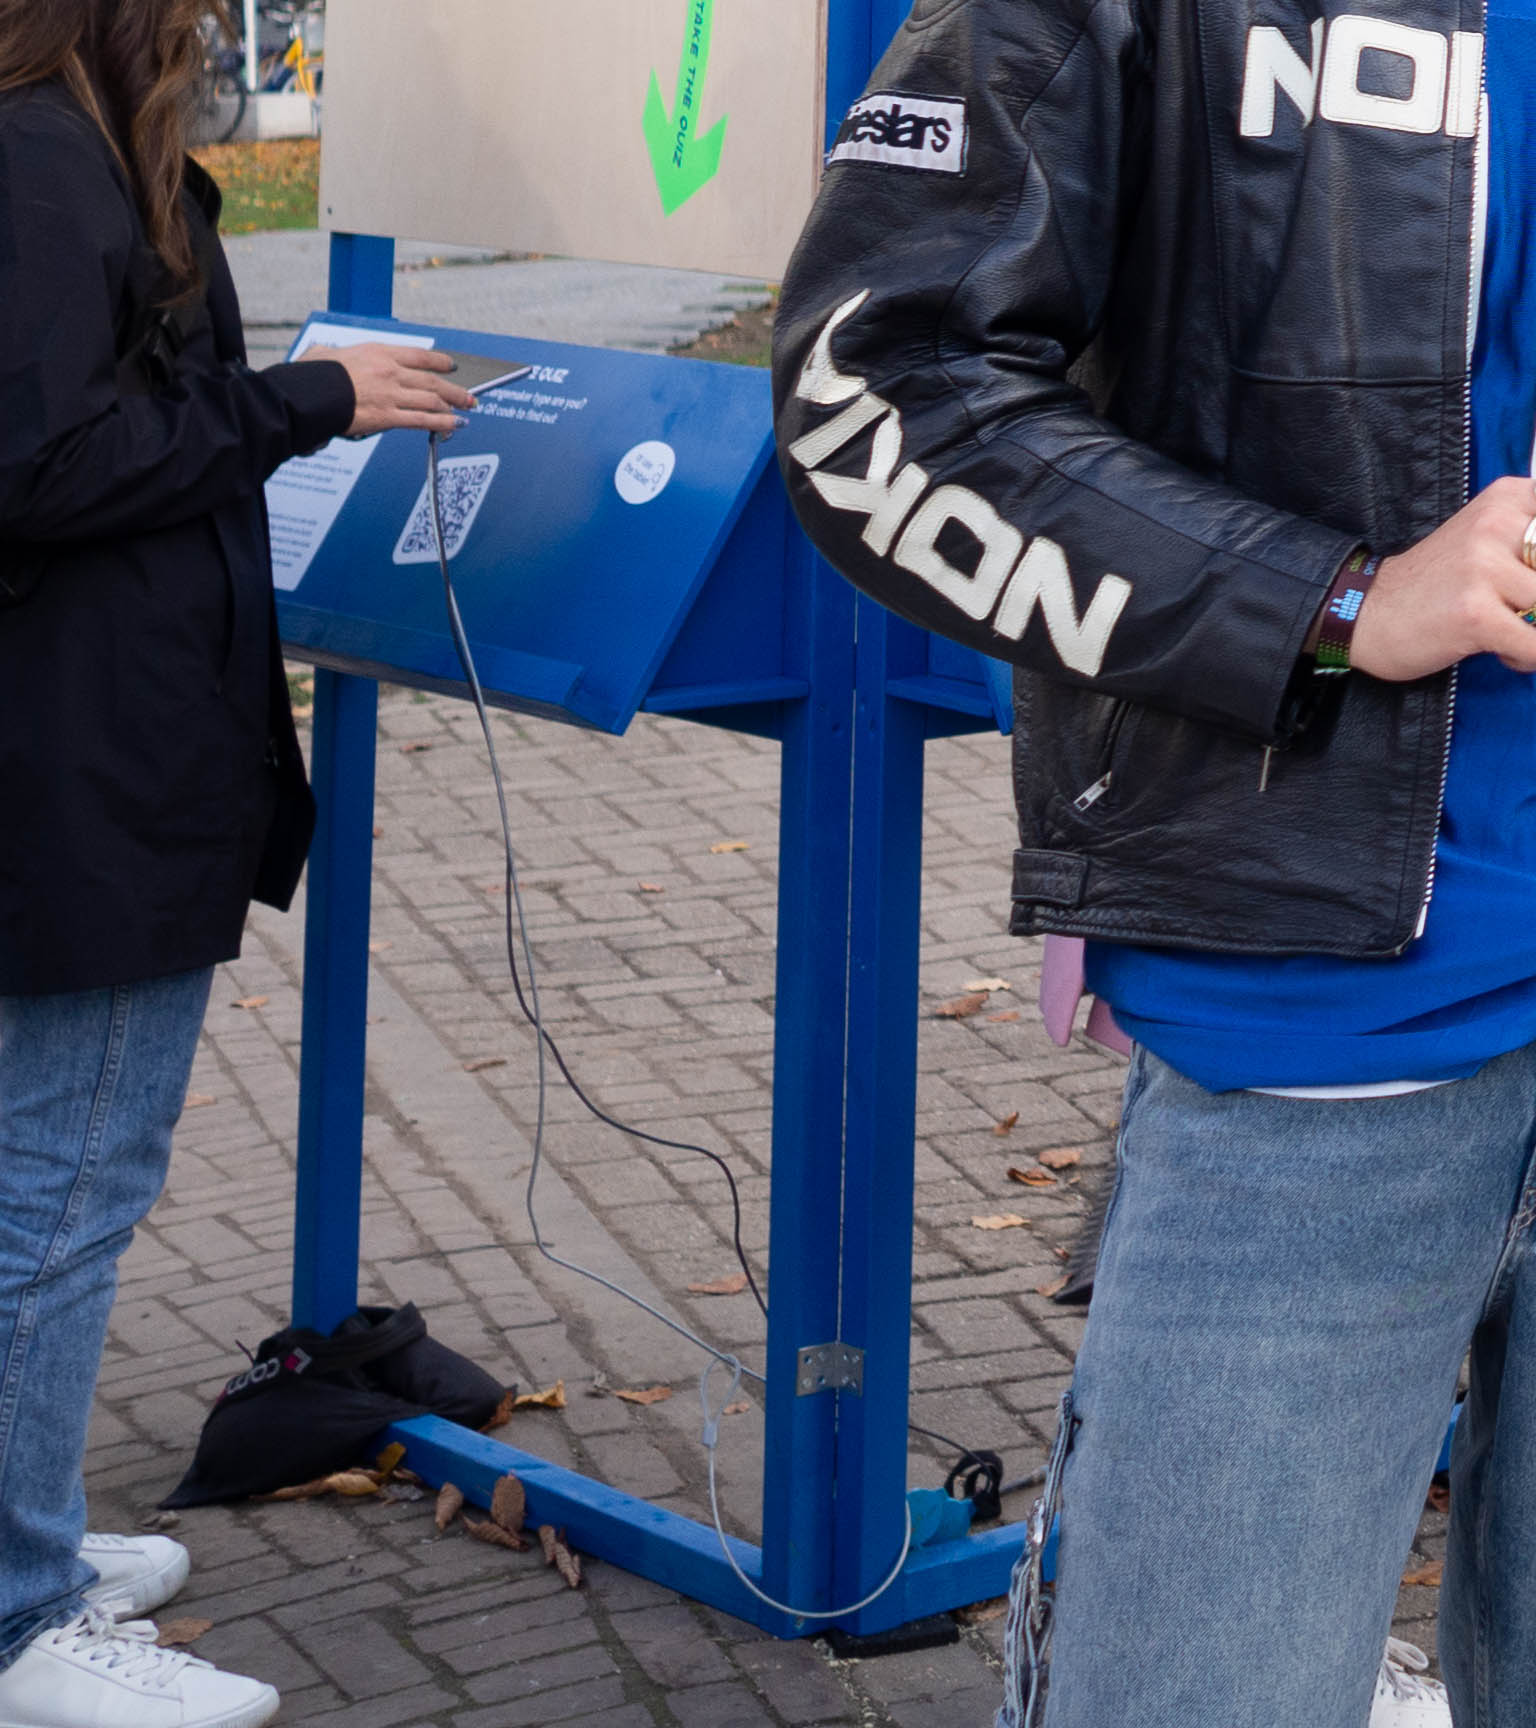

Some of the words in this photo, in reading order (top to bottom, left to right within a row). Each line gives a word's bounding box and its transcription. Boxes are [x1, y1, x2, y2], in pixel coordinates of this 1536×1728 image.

[690, 1, 705, 57] TAKE
[682, 66, 696, 109] THE
[672, 115, 688, 168] QUIZ
